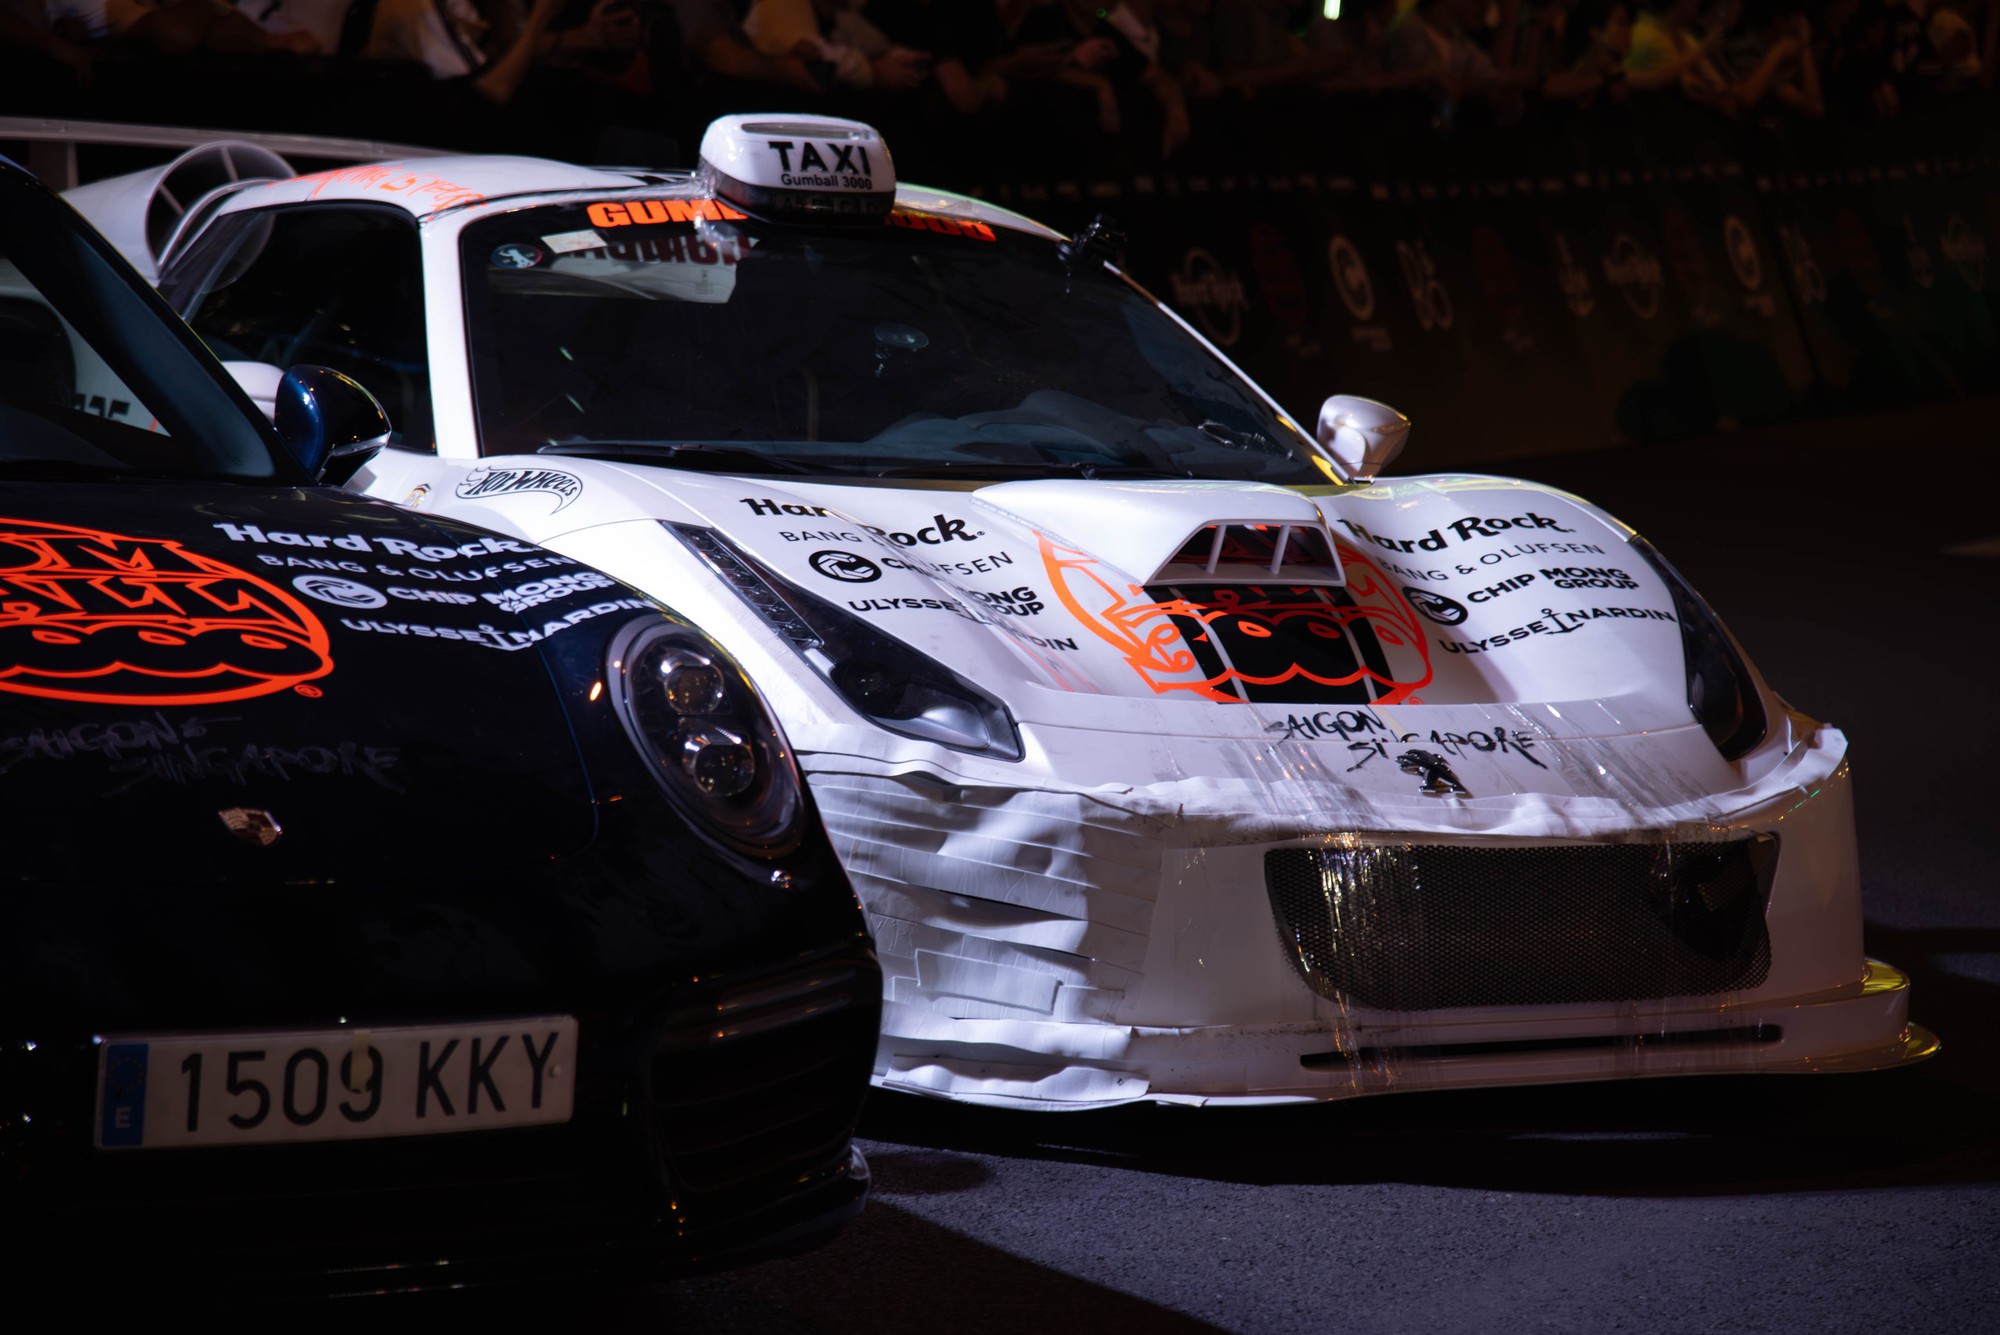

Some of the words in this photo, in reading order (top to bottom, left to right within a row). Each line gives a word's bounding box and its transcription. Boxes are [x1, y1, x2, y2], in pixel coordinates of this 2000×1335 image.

[768, 141, 872, 177] TAXI
[781, 173, 839, 188] Gumball
[843, 176, 873, 190] 3000
[739, 497, 829, 518] Har
[213, 523, 373, 553] Hard
[778, 531, 861, 544] BANG
[1336, 518, 1449, 554] Hard
[257, 554, 368, 575] BANG
[376, 563, 401, 578] &
[408, 555, 577, 582] OLUFSEN
[1376, 557, 1449, 582] BANG
[1455, 564, 1478, 576] &
[1480, 543, 1606, 565] OLUFSEN
[386, 585, 478, 606] CHIP
[481, 571, 608, 606] MONG
[498, 580, 616, 615] GROUP
[967, 586, 1038, 605] ONG
[1466, 574, 1536, 604] CHIP
[1539, 566, 1632, 581] MONG
[1554, 577, 1640, 591] GROUP
[340, 617, 487, 643] ULYSSE
[508, 599, 658, 643] NARDIN
[1437, 619, 1551, 654] ULYSSE
[1566, 606, 1678, 624] NARDIN
[1264, 706, 1386, 744] SAIGON
[180, 1044, 384, 1132] 1509
[415, 1031, 560, 1118] KKY
[114, 1105, 131, 1129] E
